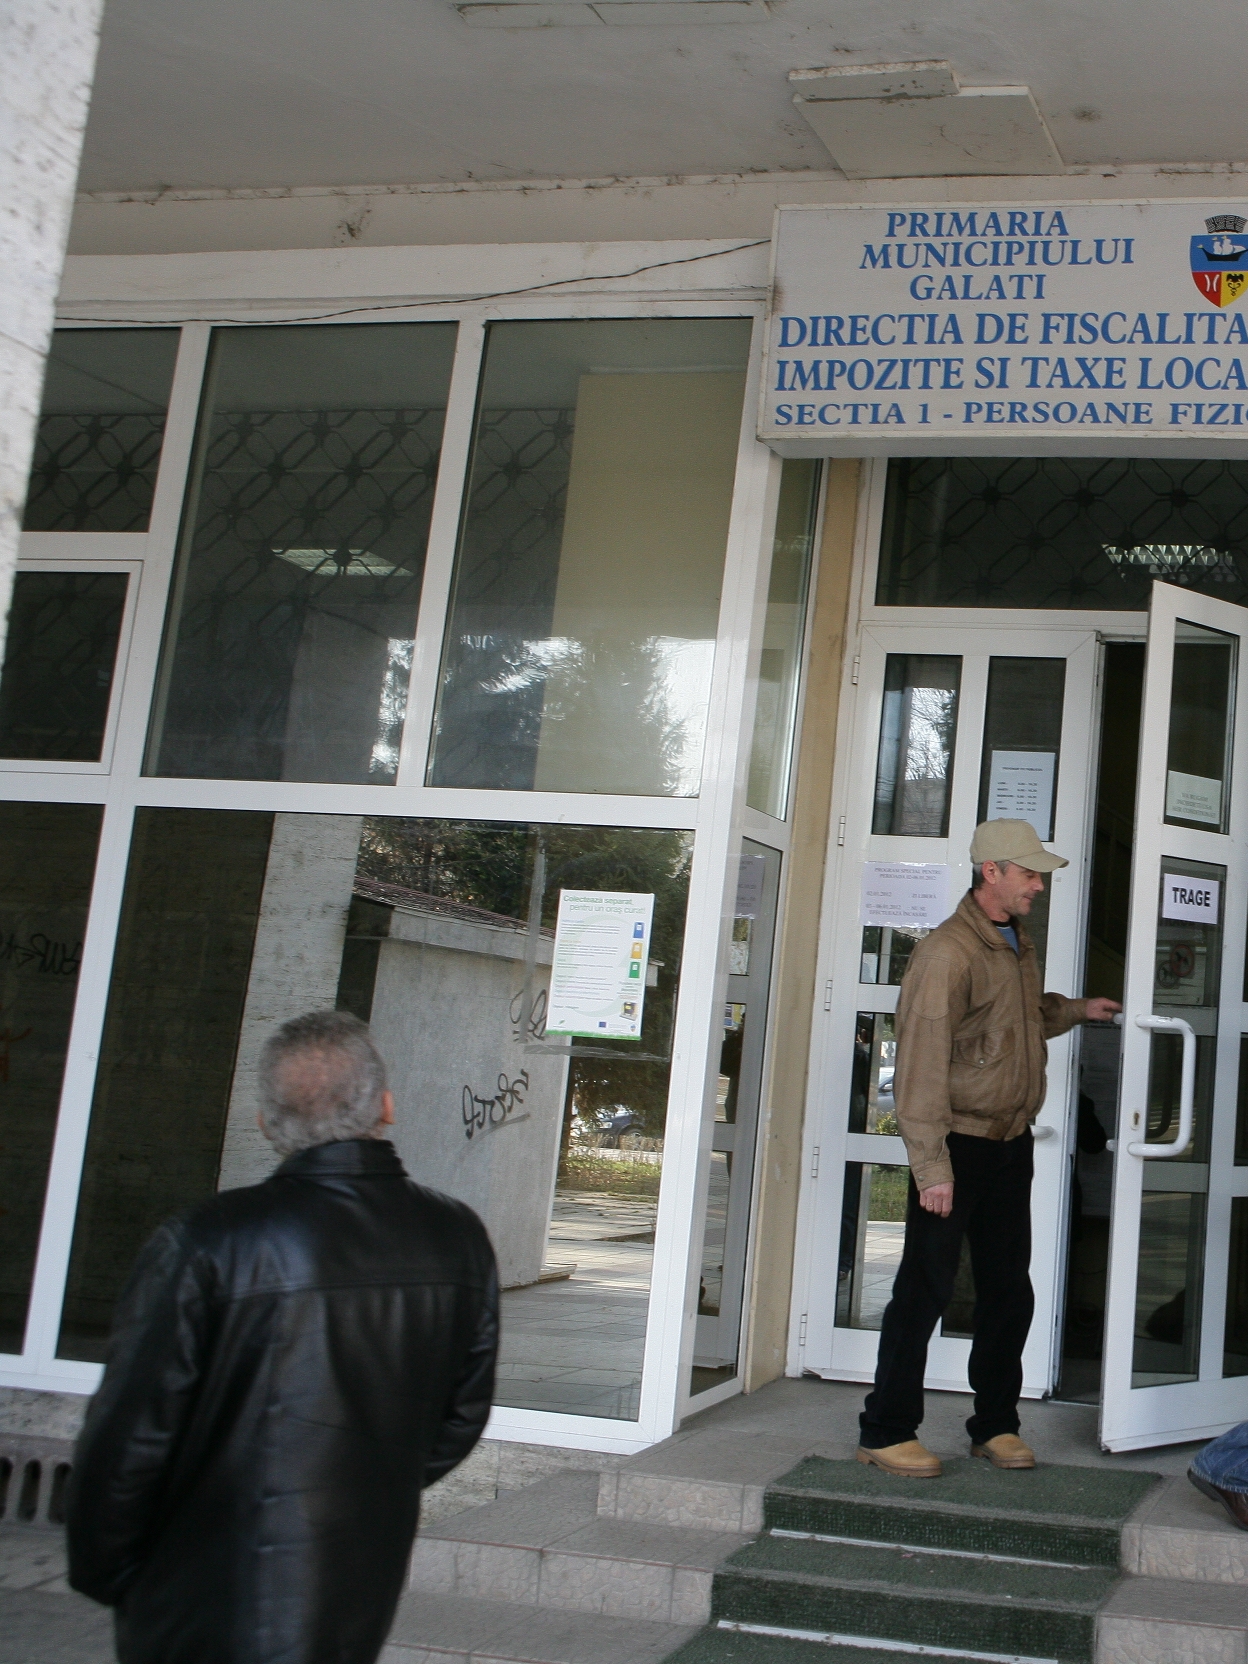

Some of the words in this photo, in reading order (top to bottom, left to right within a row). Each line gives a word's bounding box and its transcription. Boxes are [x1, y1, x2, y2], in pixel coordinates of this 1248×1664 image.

[885, 211, 1070, 238] PRIMARIA
[859, 238, 1135, 270] MUNICIPIULUI
[909, 274, 1047, 301] GALATI
[778, 314, 964, 348] DIRECTIA
[974, 313, 1029, 345] DE
[774, 358, 963, 392] IMPOZITE
[974, 357, 1011, 390] SI
[1022, 357, 1128, 390] TAXE
[774, 404, 906, 426] SECTIA
[964, 402, 1153, 424] PERSOANE
[1172, 886, 1211, 907] TRAGE
